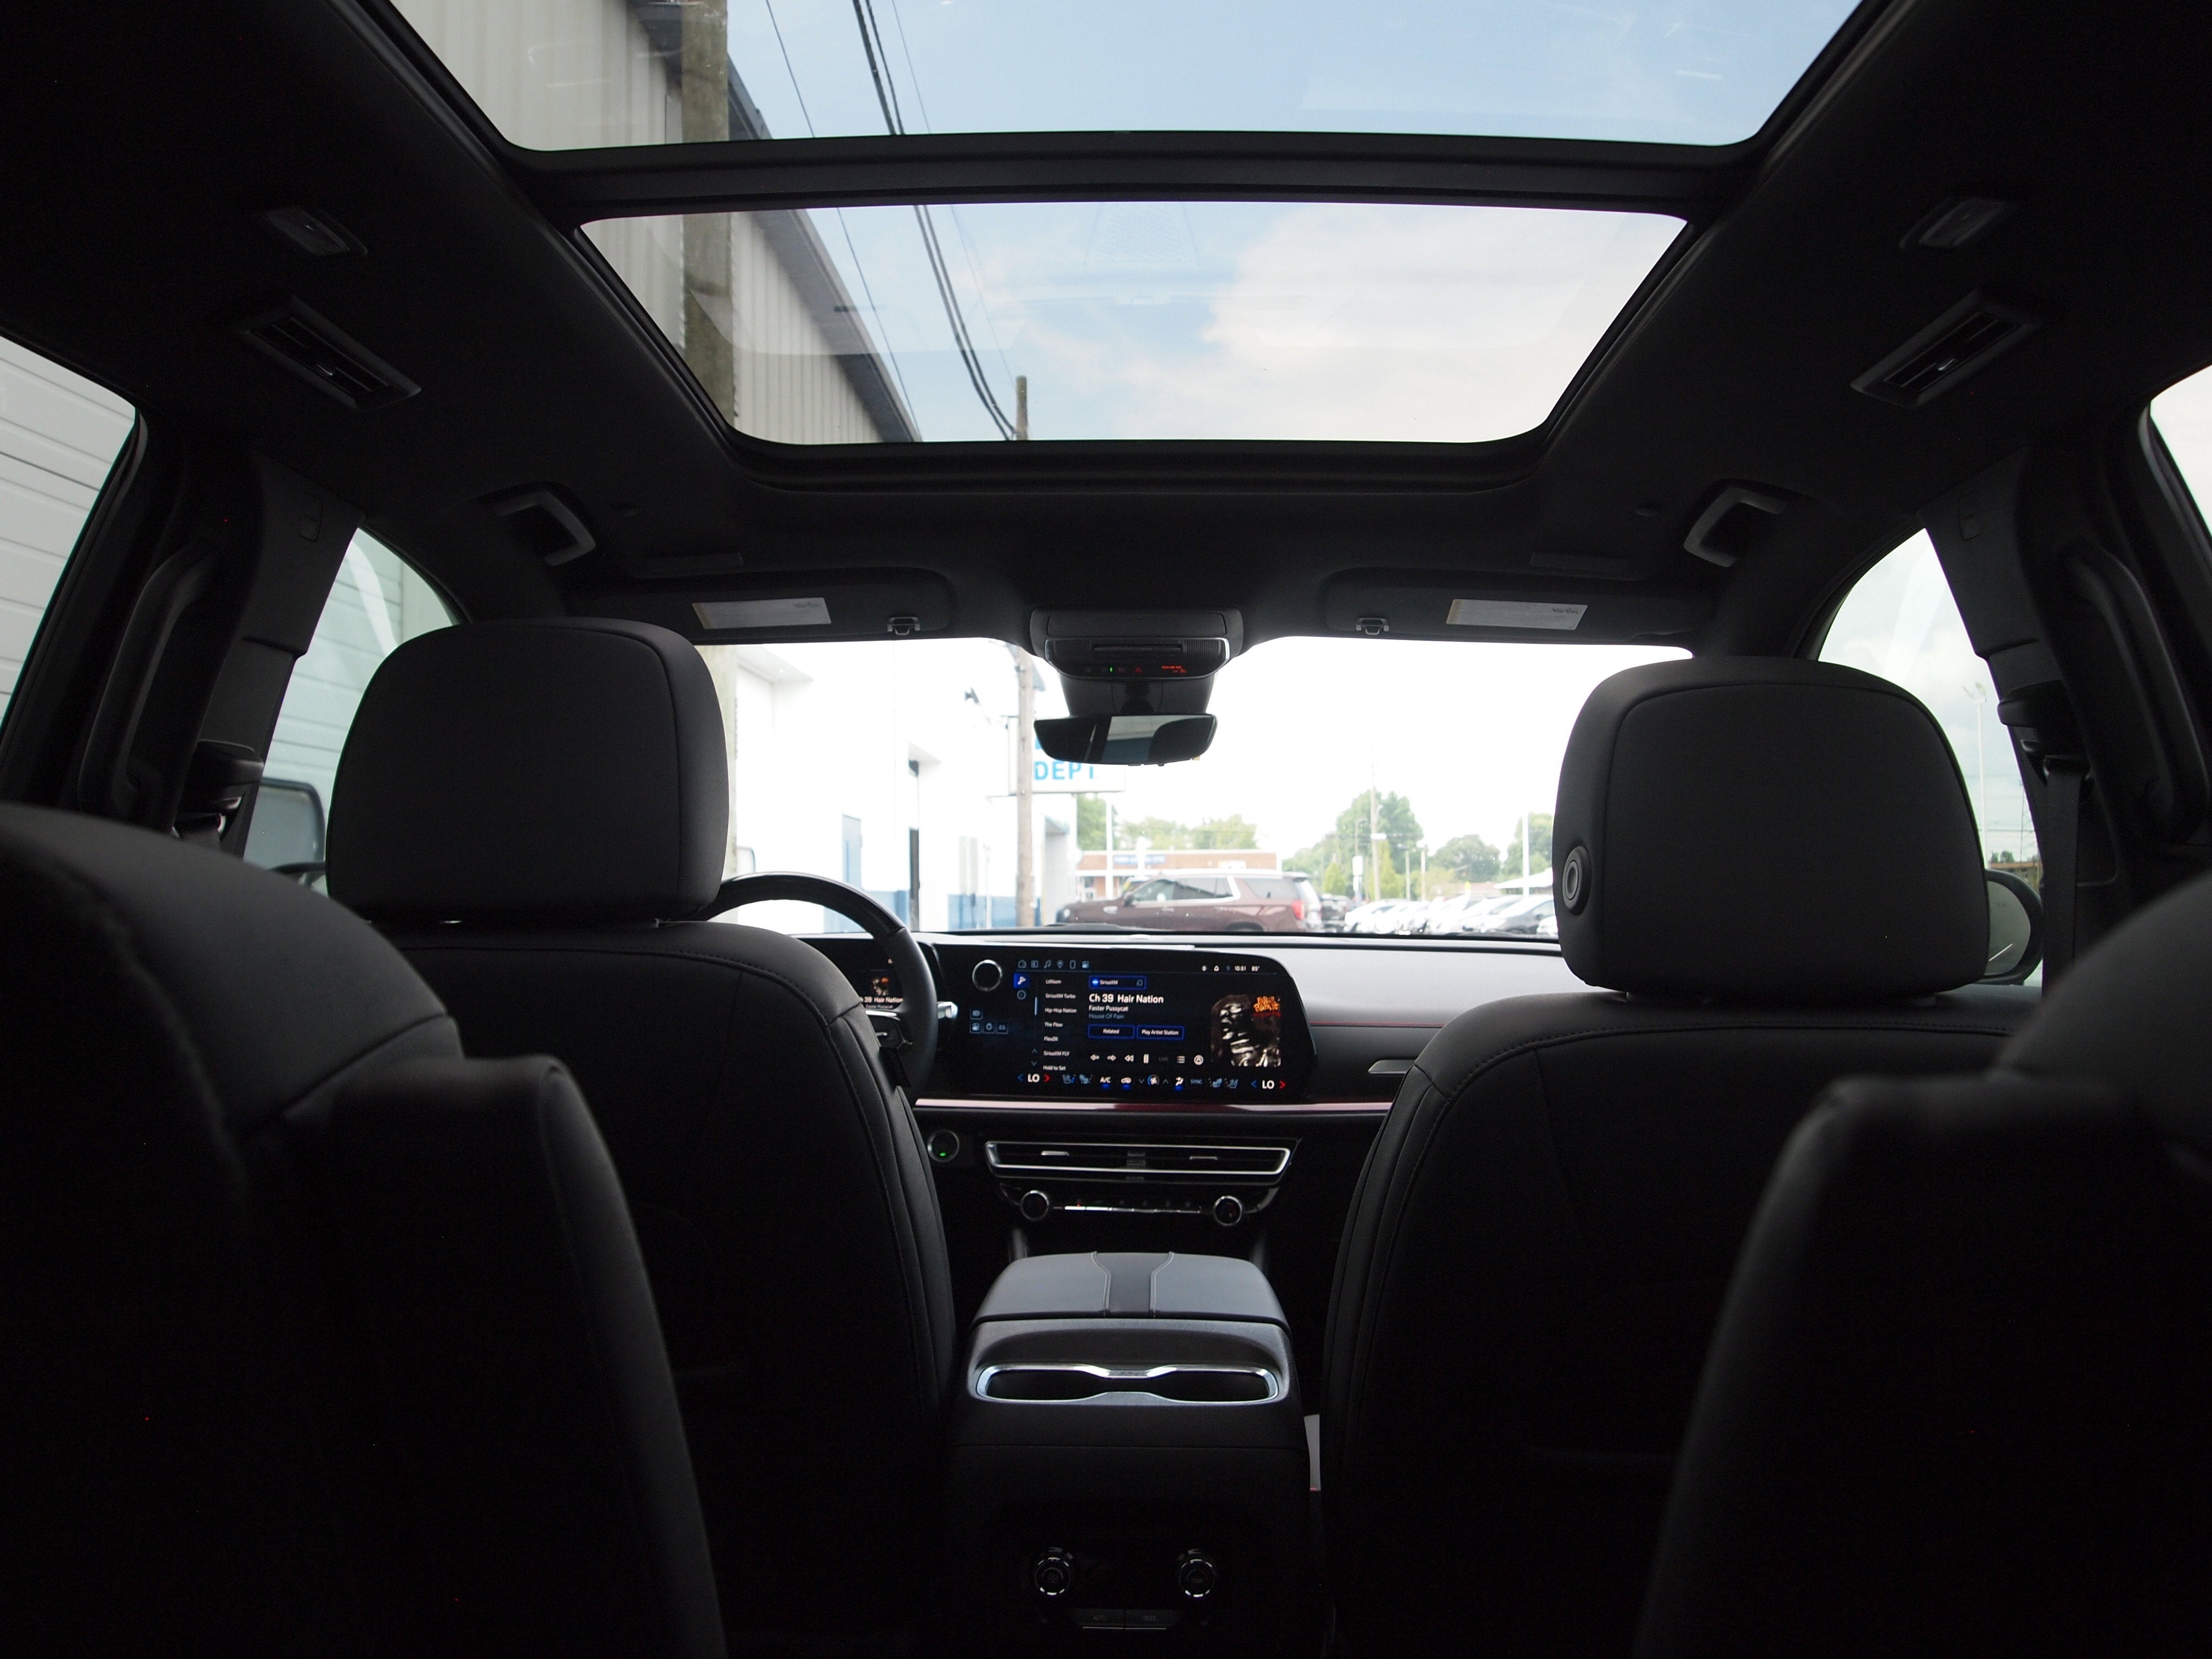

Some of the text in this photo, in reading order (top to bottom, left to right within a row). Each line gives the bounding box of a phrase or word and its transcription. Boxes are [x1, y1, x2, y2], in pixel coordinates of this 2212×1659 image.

[1088, 993, 1164, 1004] Ch 39 Hair Nation
[1028, 1074, 1040, 1083] LO
[1262, 1079, 1275, 1090] LO
